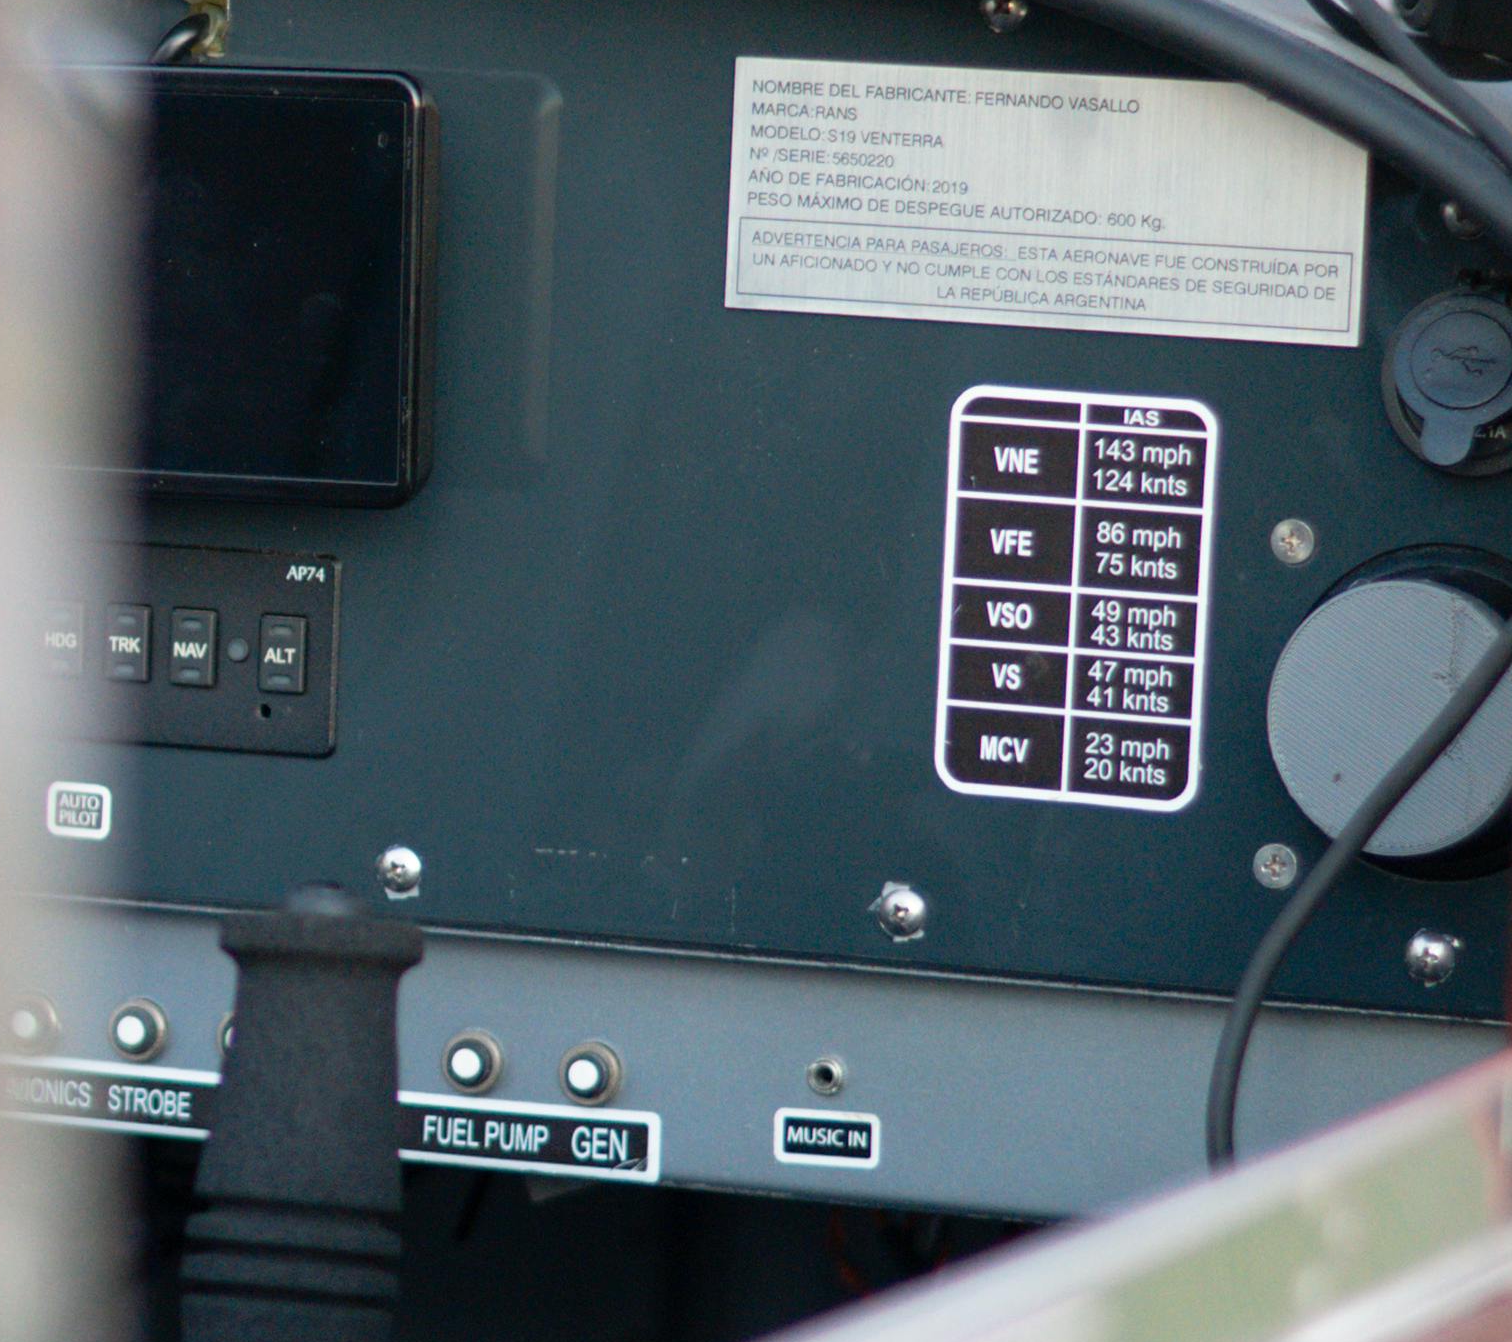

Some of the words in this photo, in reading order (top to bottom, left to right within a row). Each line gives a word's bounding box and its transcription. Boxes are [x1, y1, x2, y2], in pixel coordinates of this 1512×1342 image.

[752, 80, 824, 96] NOMBRE
[829, 83, 860, 98] DEL
[865, 85, 970, 104] FABRICANTE:
[975, 92, 1063, 109] FERNANDO
[1069, 97, 1140, 113] VASALLO
[861, 131, 944, 148] VENTERRA
[748, 167, 783, 184] AÑO
[789, 172, 810, 185] DE
[747, 191, 792, 207] PESO
[797, 191, 863, 211] MÁXIMO
[868, 199, 890, 213] DE
[895, 200, 984, 218] DESPEGUE
[990, 206, 1102, 225] AUTORIZADO:
[1107, 212, 1136, 227] 600
[1141, 215, 1165, 232] Kg.
[752, 231, 861, 249] ADVERTENCIA
[866, 236, 906, 252] PARA
[911, 240, 1007, 258] PASAJEROS:
[1018, 246, 1058, 261] ESTA
[1062, 249, 1149, 267] AERONAVE
[1155, 254, 1186, 269] FUE
[1192, 257, 1298, 276] CONSTRUÍDA
[1304, 264, 1338, 278] POR
[753, 253, 775, 266] UN
[780, 254, 876, 272] AFICIONADO
[882, 261, 892, 273] Y
[897, 261, 919, 275] NO
[925, 263, 990, 279] CUMPLE
[995, 267, 1031, 282] CON
[1036, 270, 1068, 284] LOS
[1073, 270, 1180, 291] ESTÁNDARES
[1186, 279, 1207, 292] DE
[1212, 280, 1308, 299] SEGURIDAD
[1314, 287, 1335, 301] DE
[937, 287, 956, 300] LA
[961, 284, 1049, 305] REPÚBLICA
[1054, 292, 1146, 311] ARGENTINA
[1123, 409, 1160, 427] IAS
[994, 446, 1039, 474] VNE
[1094, 439, 1136, 460] 143
[1141, 444, 1192, 466] mph
[1092, 469, 1134, 491] 124
[1140, 472, 1188, 497] knts
[990, 528, 1033, 557] VFE
[1096, 522, 1126, 544] 86
[1132, 527, 1182, 550] mph
[286, 566, 325, 583] AP74
[1095, 552, 1124, 575] 75
[1130, 555, 1178, 580] knts
[986, 600, 1033, 630] VSO
[1091, 600, 1120, 623] 49
[1128, 605, 1176, 628] mph
[45, 632, 77, 649] HDG
[109, 636, 141, 653] TRK
[173, 642, 207, 660] NAV
[1090, 624, 1120, 646] 43
[1127, 626, 1174, 651] knts
[264, 647, 296, 664] ALT
[992, 663, 1021, 690] VS
[1087, 660, 1118, 682] 47
[1124, 665, 1173, 688] mph
[1086, 685, 1114, 707] 41
[1122, 687, 1170, 713] knts
[980, 734, 1029, 763] MCV
[1084, 732, 1114, 755] 23
[1120, 738, 1170, 761] mph
[1084, 758, 1113, 781] 20
[1119, 761, 1166, 786] knts
[60, 792, 100, 810] AUTO
[59, 810, 99, 827] PILOT
[107, 1084, 192, 1119] STROBE
[423, 1115, 480, 1148] FUEL
[484, 1120, 549, 1153] PUMP
[571, 1126, 628, 1161] GEN
[787, 1125, 844, 1147] MUSIC
[848, 1130, 867, 1148] IN
